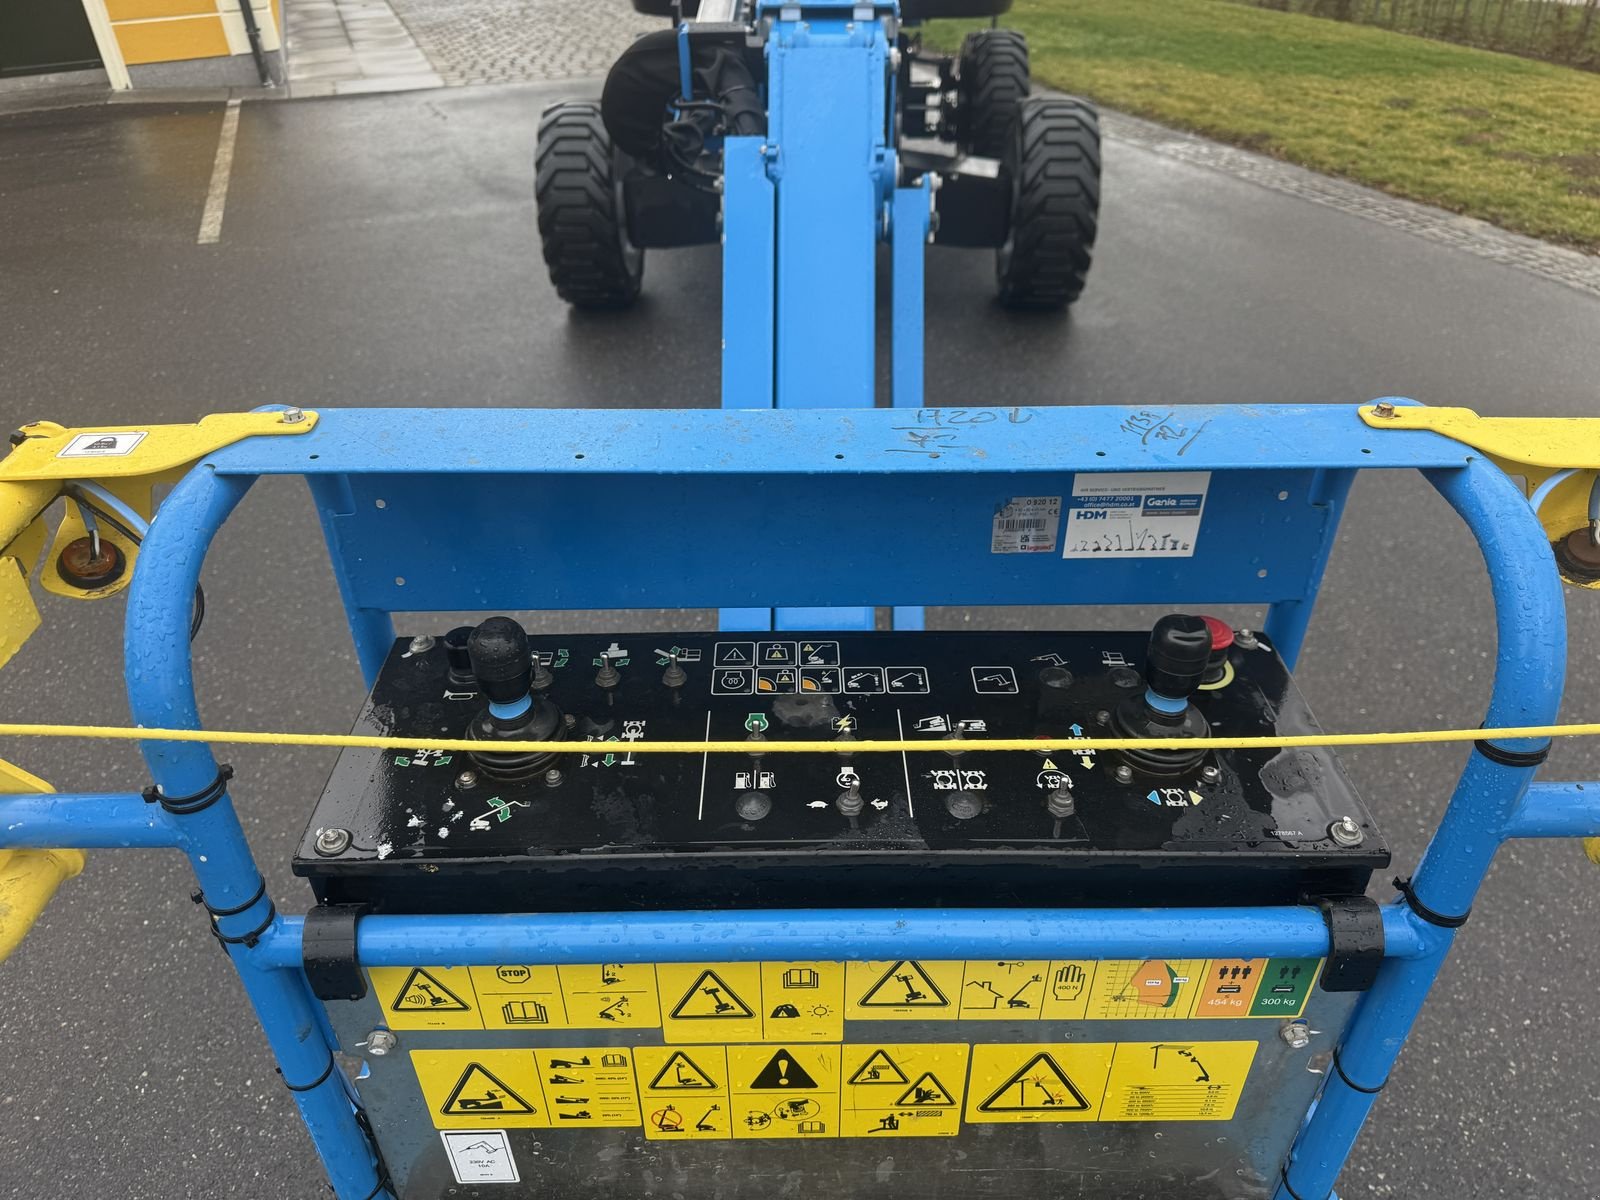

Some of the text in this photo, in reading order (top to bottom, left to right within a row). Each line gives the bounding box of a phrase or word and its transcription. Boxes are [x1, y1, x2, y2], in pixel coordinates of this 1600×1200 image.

[1147, 497, 1177, 506] Genie
[1075, 510, 1108, 520] HDM
[500, 969, 526, 977] STOP
[1230, 998, 1243, 1006] kg
[1283, 998, 1296, 1006] kg
